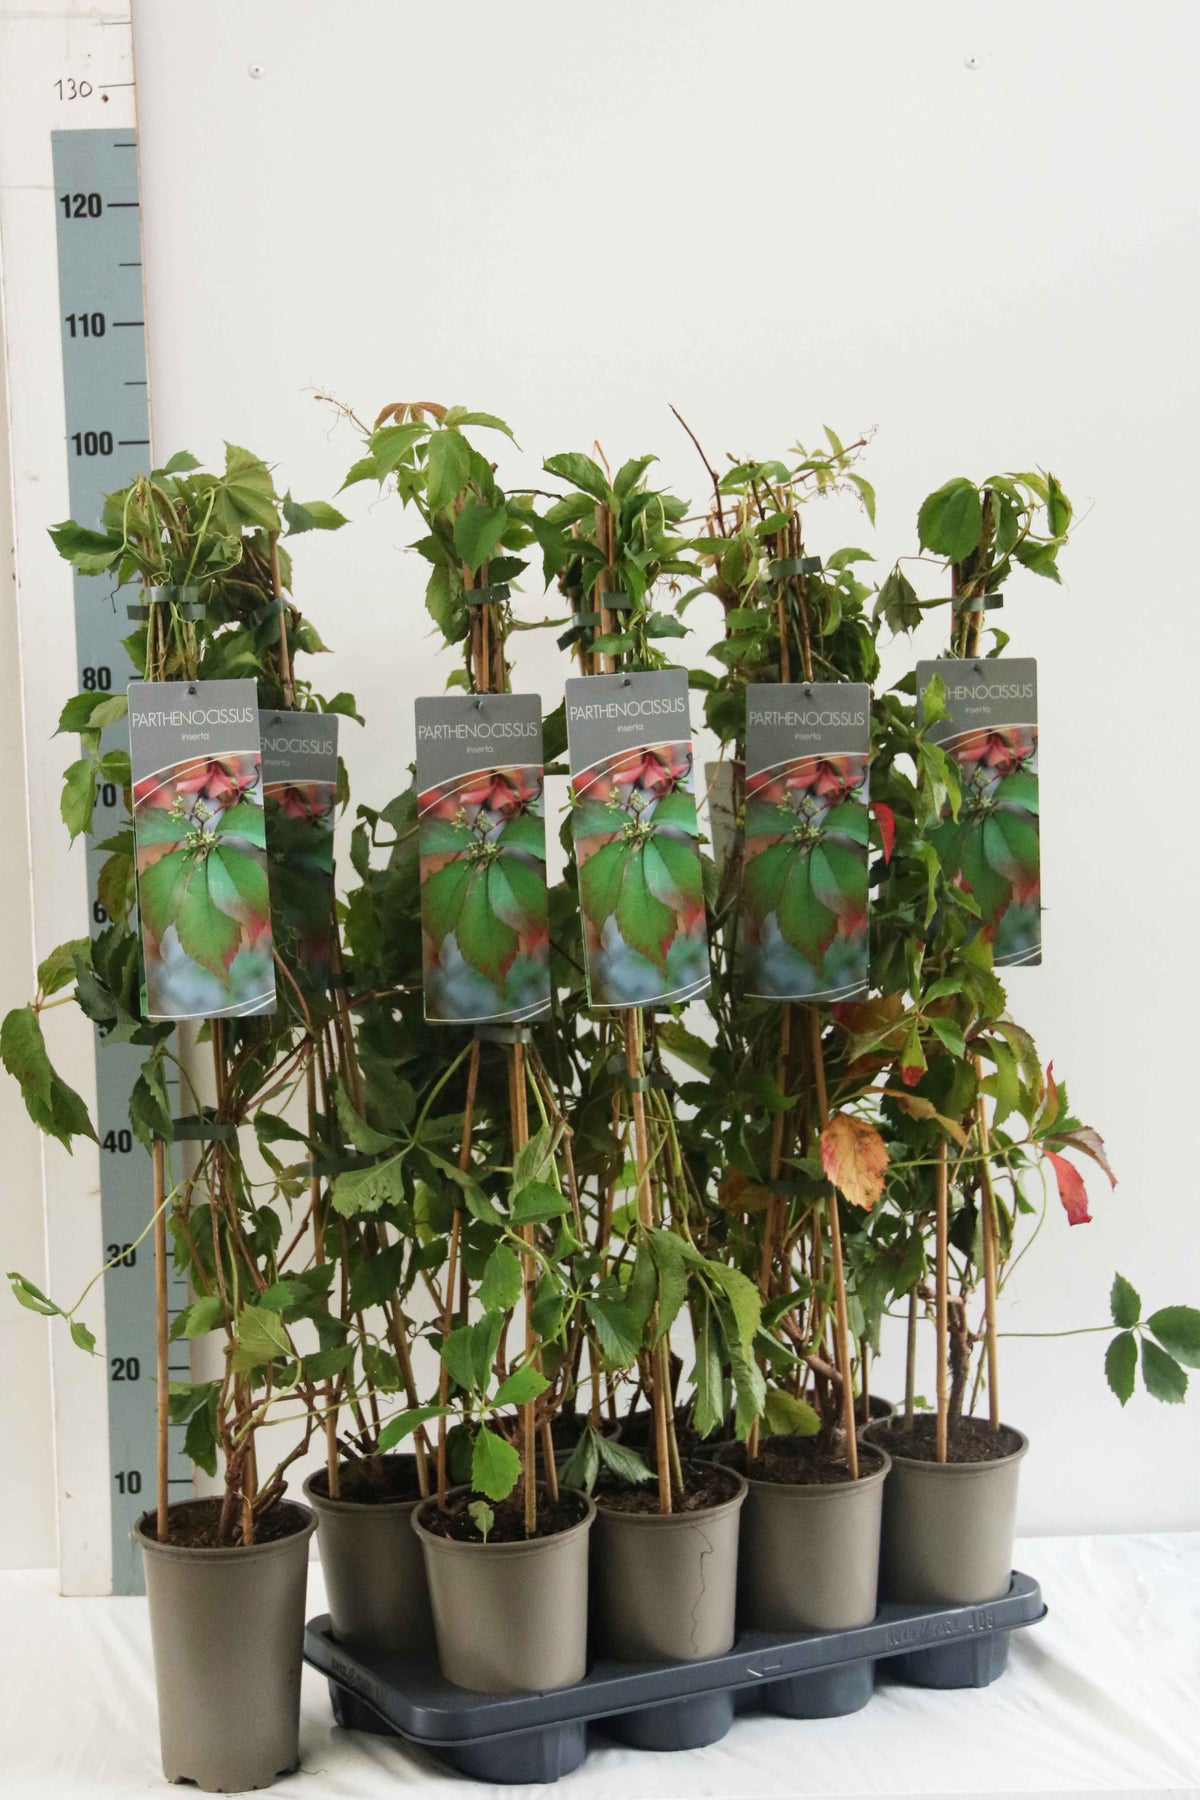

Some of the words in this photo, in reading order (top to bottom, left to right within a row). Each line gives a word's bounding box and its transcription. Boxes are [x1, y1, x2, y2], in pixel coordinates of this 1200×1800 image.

[53, 78, 94, 101] 130
[60, 192, 103, 219] 120
[65, 312, 106, 338] 110
[71, 431, 114, 456] 100
[82, 666, 112, 692] 80
[919, 683, 1034, 701] PHENOCISSUS
[131, 707, 254, 728] PARTHENOCISSUS
[569, 697, 686, 721] PARTHENOCISSUS
[749, 710, 865, 727] PARTHENOCISSUS
[180, 730, 210, 741] inserta
[418, 721, 538, 740] PARTHENOCISSUS
[617, 722, 644, 733] inserta
[794, 731, 821, 742] inserta
[466, 744, 494, 754] inserta
[103, 1128, 133, 1154] 40
[106, 1243, 137, 1269] 30
[111, 1356, 140, 1382] 20
[114, 1470, 142, 1495] 10
